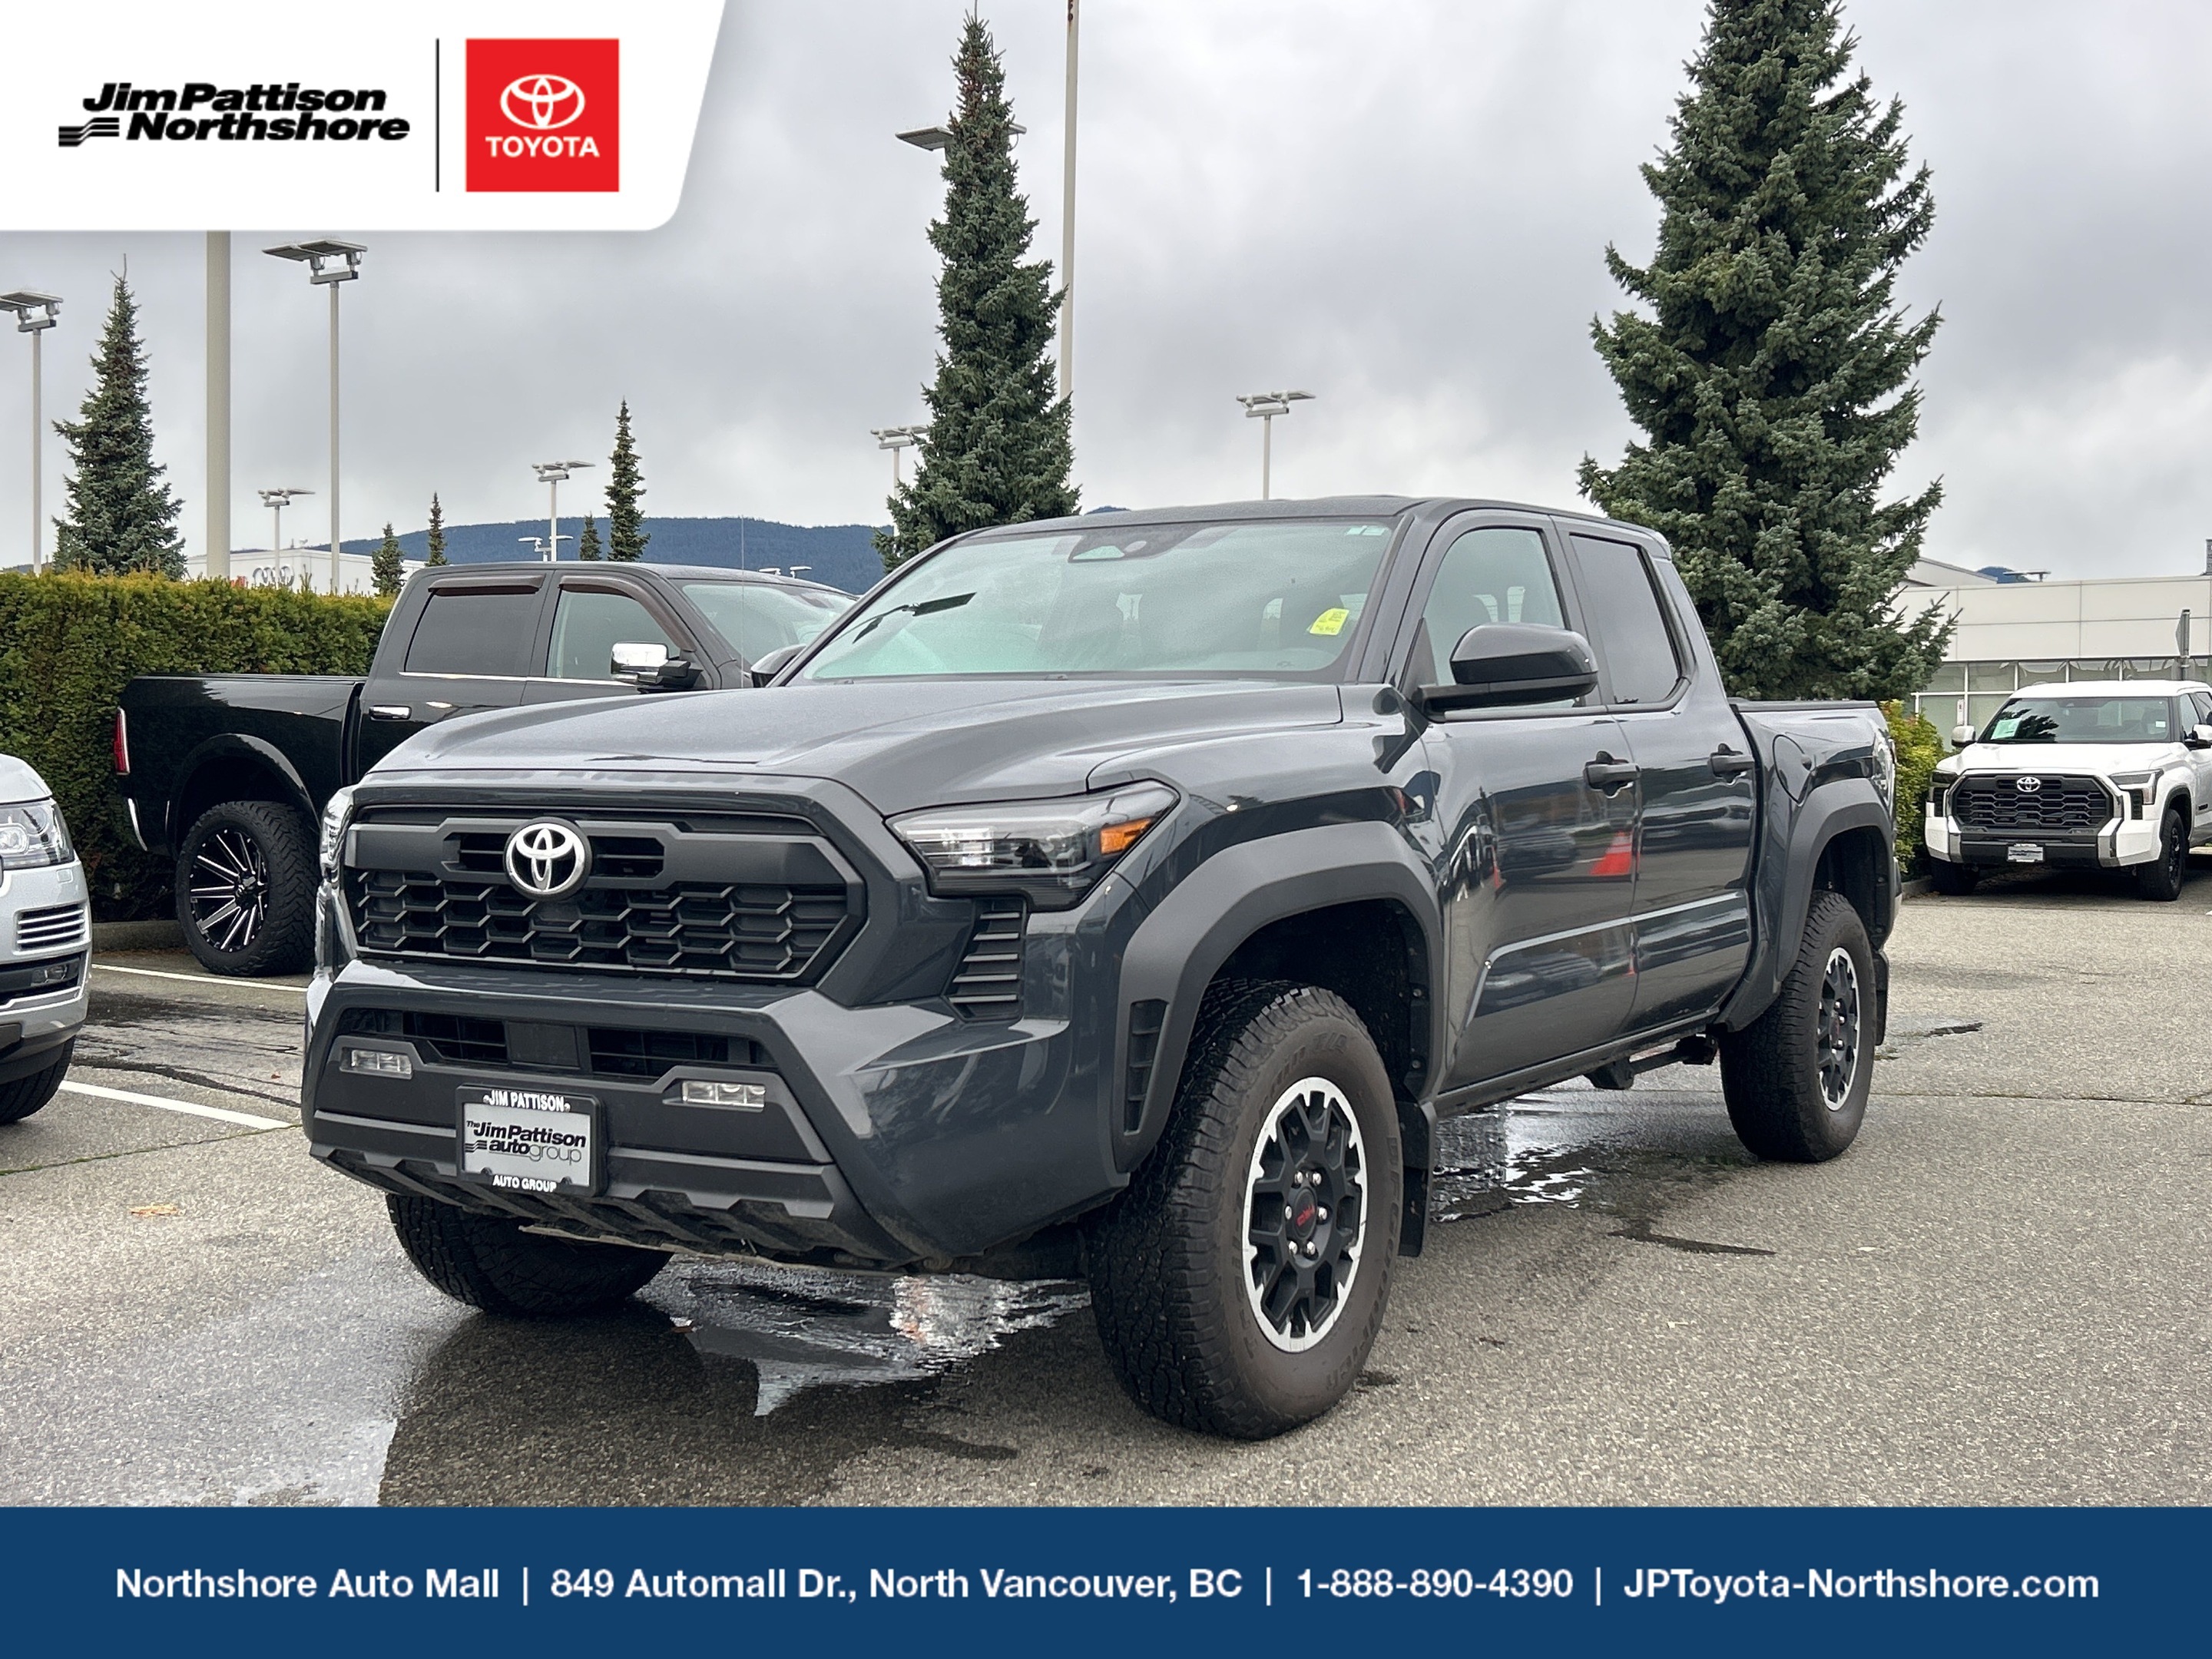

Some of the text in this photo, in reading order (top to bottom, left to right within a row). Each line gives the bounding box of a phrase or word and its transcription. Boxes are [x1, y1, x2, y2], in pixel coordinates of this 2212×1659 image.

[488, 1089, 565, 1112] JIM PATTISON
[465, 1120, 481, 1128] The
[492, 1174, 558, 1193] AUTO GROUP
